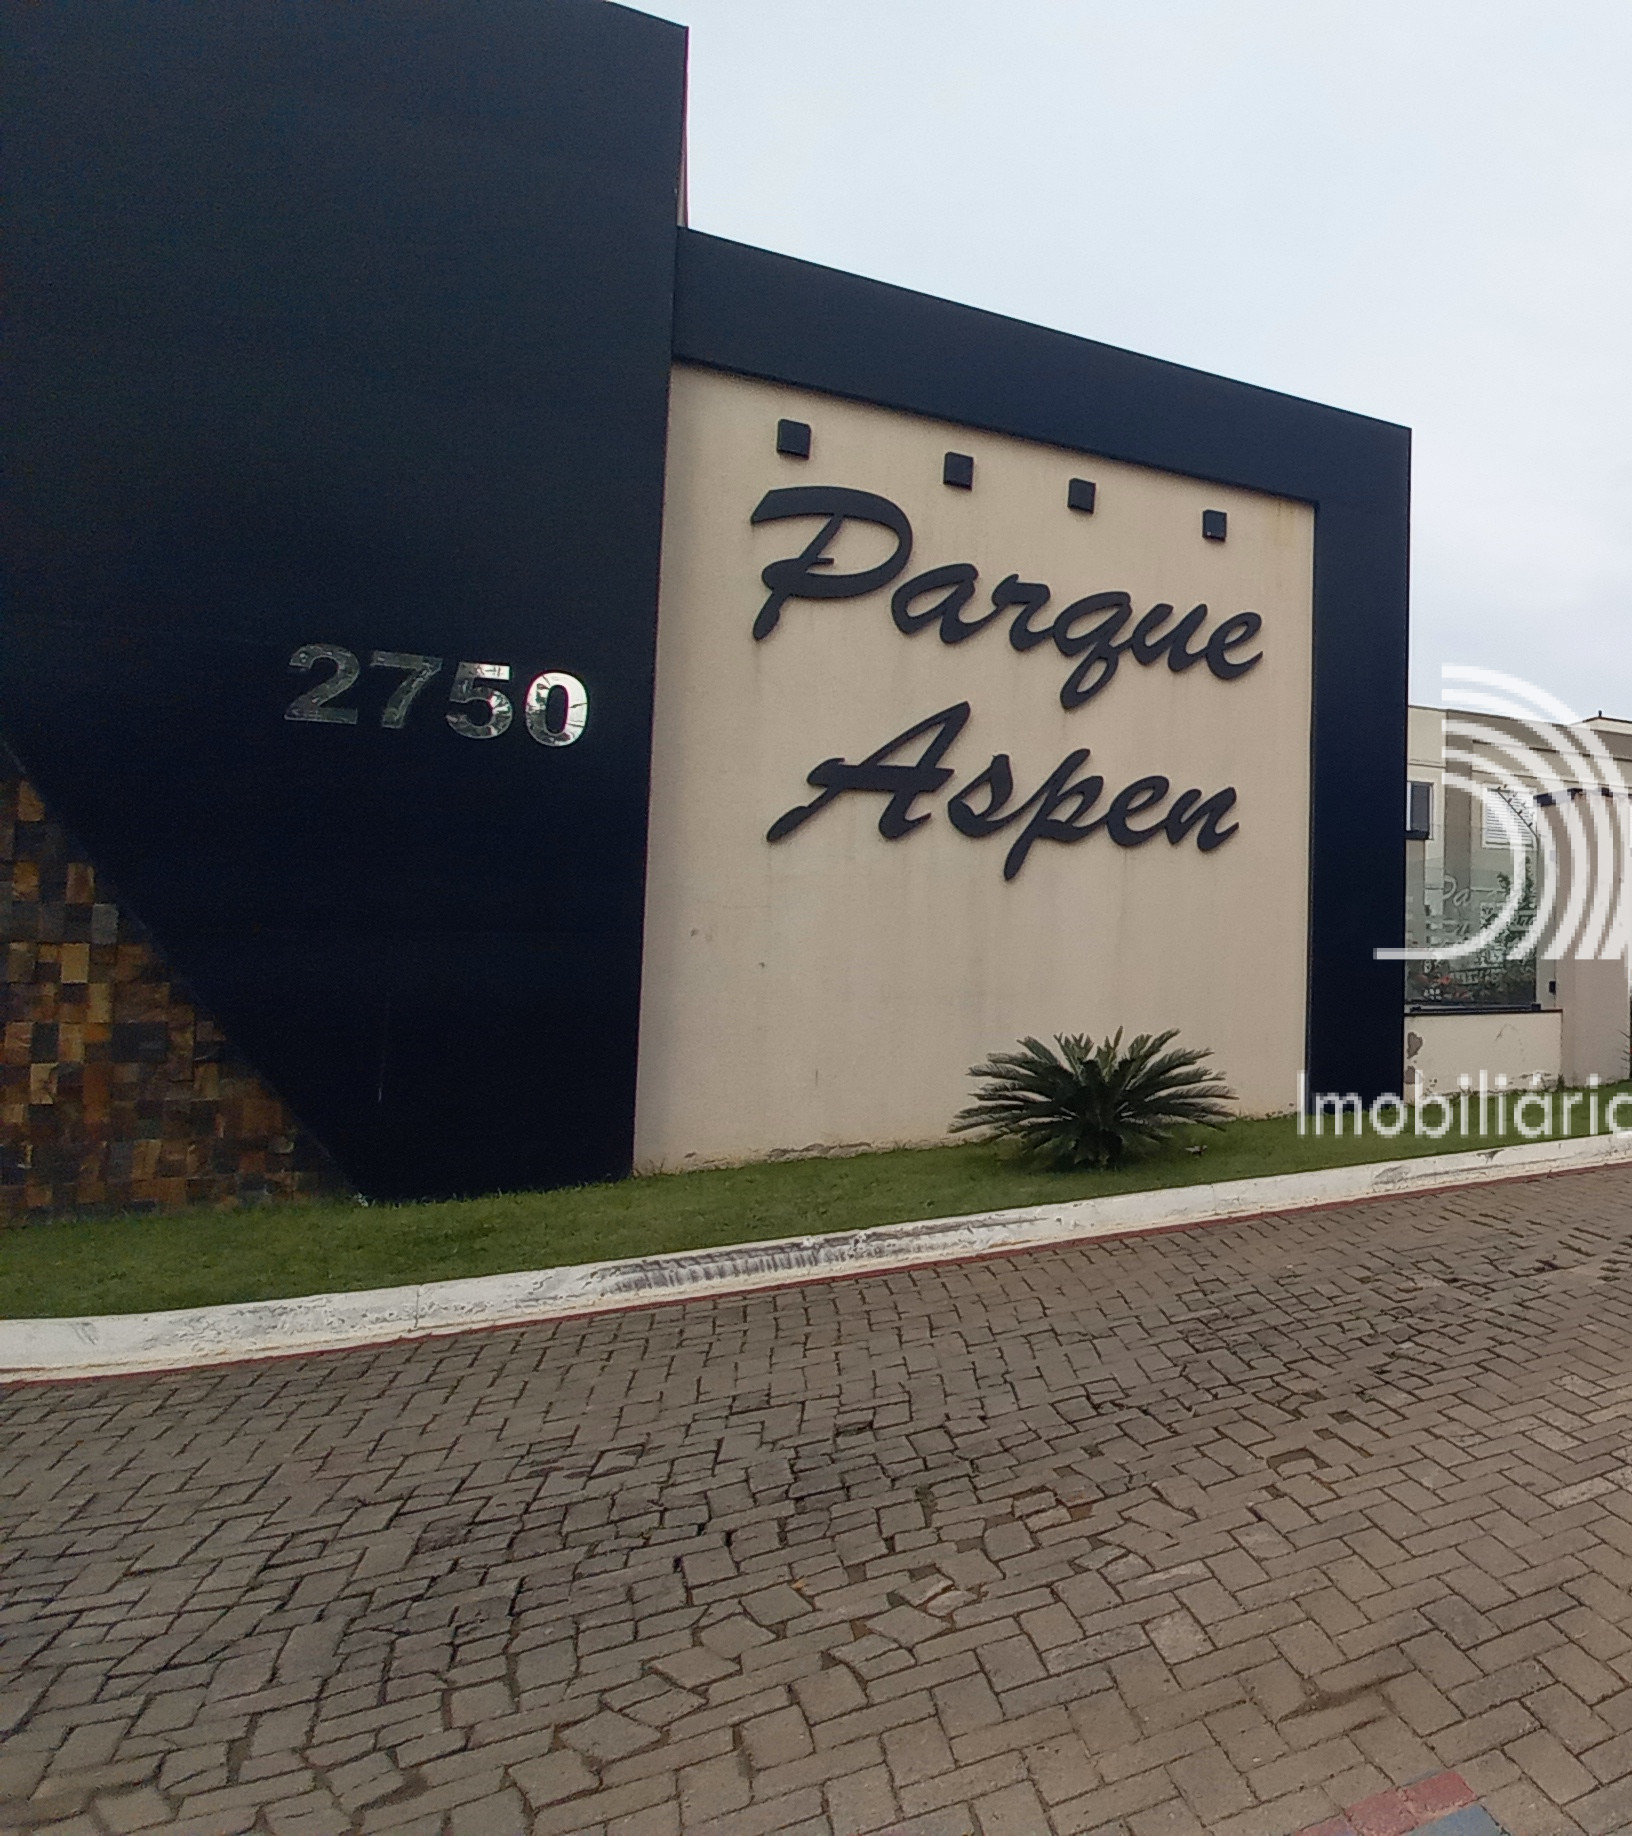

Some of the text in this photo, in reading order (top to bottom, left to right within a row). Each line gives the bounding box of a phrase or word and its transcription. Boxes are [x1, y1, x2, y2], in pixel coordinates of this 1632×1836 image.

[751, 485, 1263, 710] Parque
[284, 643, 590, 747] 2750
[765, 701, 1240, 881] Aspen
